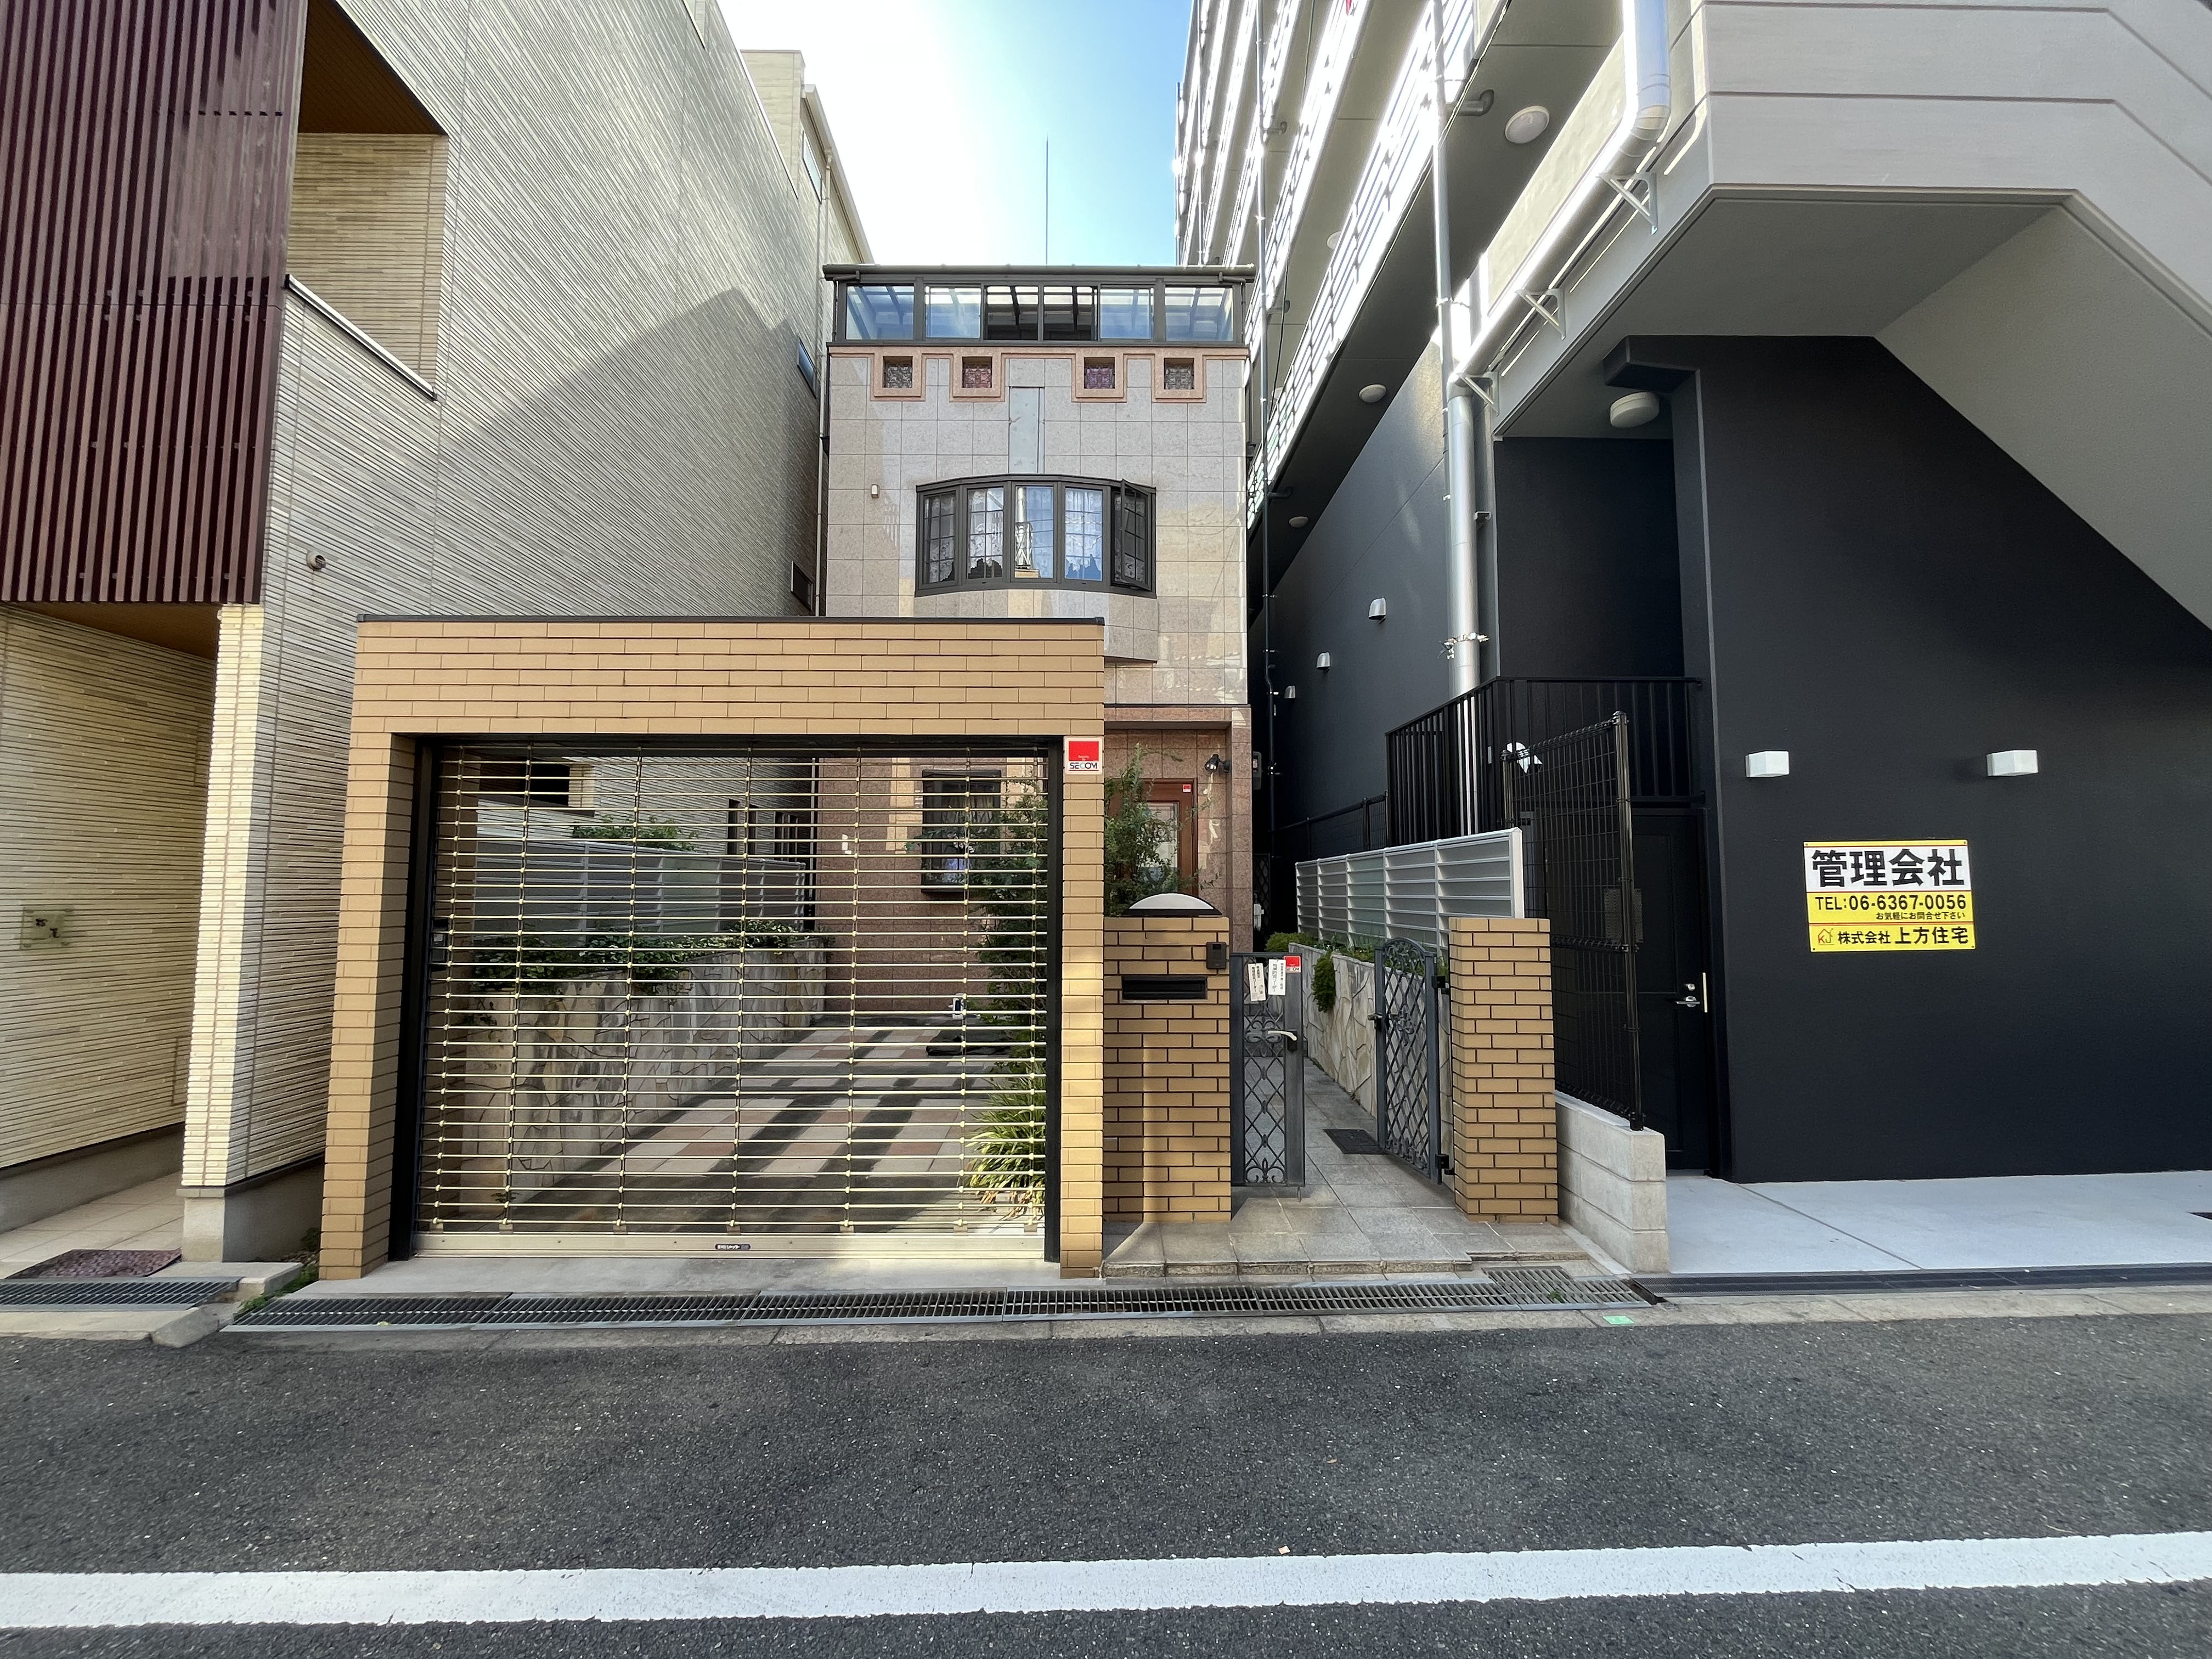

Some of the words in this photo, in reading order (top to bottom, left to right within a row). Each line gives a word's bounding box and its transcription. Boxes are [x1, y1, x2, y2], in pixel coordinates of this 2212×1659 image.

[1812, 848, 1965, 887] 管理会社
[1814, 894, 1967, 910] TEL:06-6367-0056
[1876, 912, 1966, 920] お気軽にお問合せ下さい
[1837, 931, 1891, 945] 株式会社
[1894, 926, 1969, 944] 上方住宅
